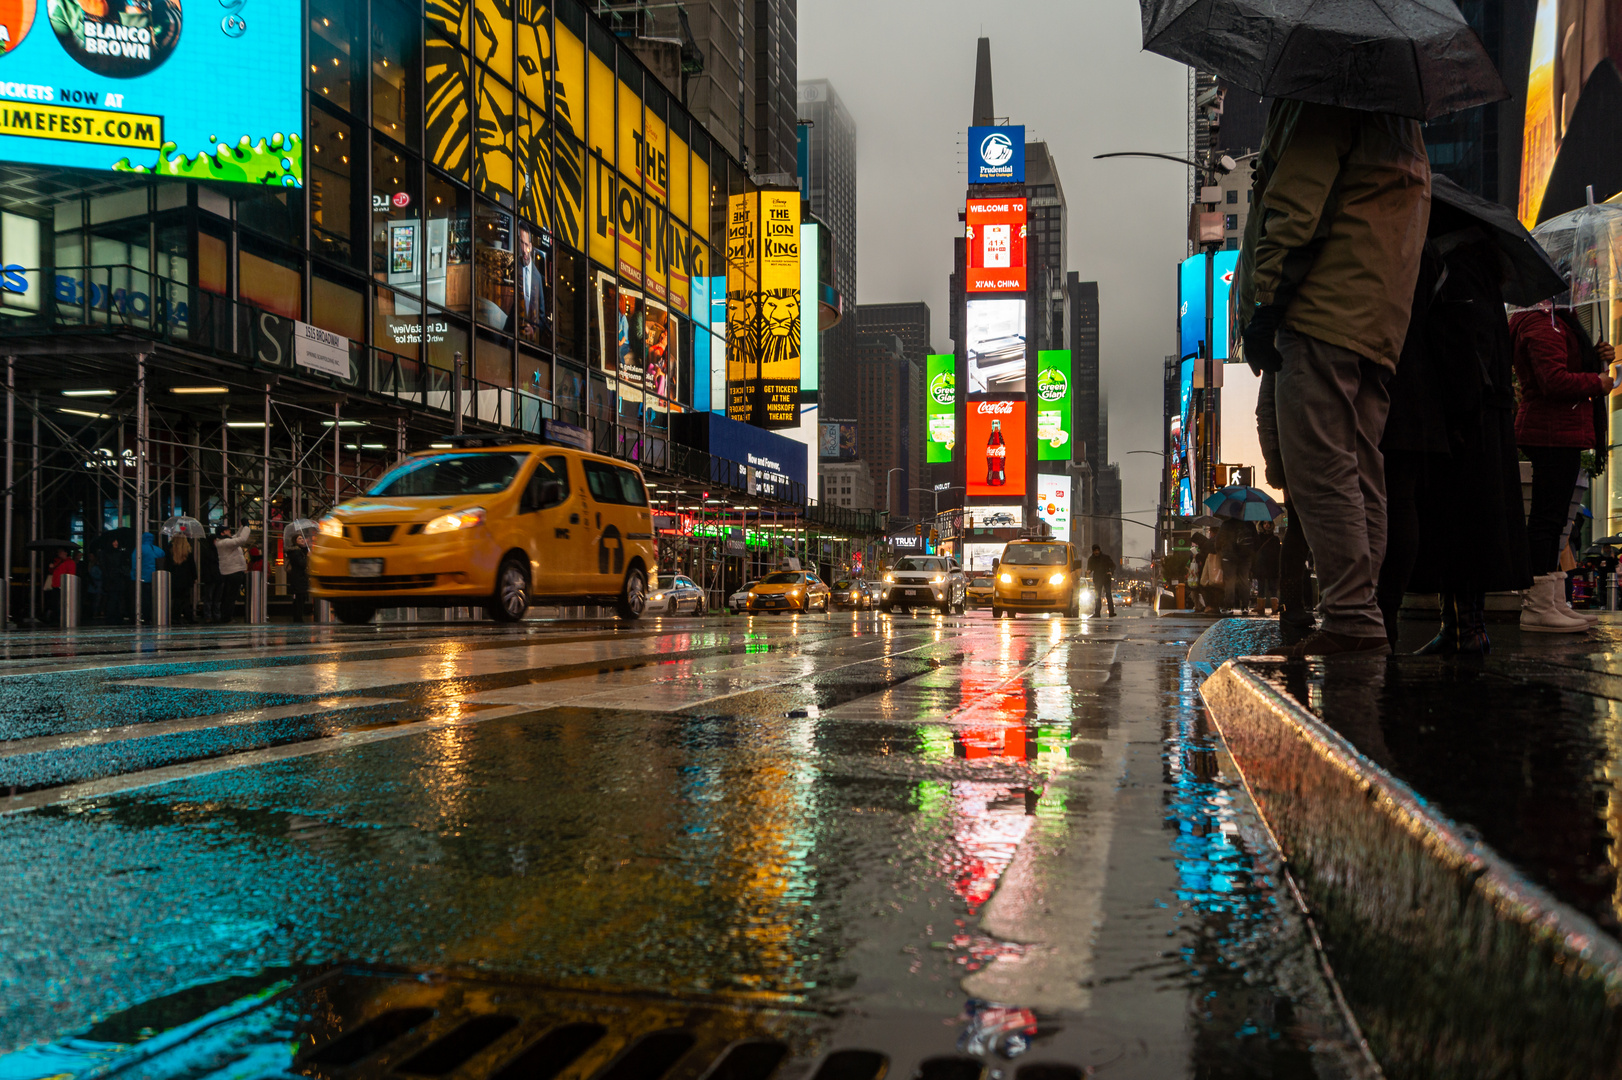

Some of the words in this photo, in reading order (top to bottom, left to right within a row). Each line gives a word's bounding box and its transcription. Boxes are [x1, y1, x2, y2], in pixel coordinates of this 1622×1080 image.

[84, 20, 151, 44] BLANCO
[85, 37, 151, 60] BROWN
[60, 88, 99, 105] NOW
[104, 93, 124, 108] AT
[0, 109, 155, 141] IMEFEST.COM
[633, 128, 666, 189] THE
[980, 165, 1013, 174] Prudential
[769, 209, 789, 219] THE
[970, 204, 1009, 212] WELCOME
[1013, 204, 1024, 212] TO
[596, 146, 652, 250] LION
[655, 195, 704, 286] KING
[766, 220, 793, 237] LION
[764, 238, 798, 258] KING
[620, 261, 642, 285] ENTRANCE
[646, 276, 654, 290] ON
[975, 280, 996, 288] XI'AN,
[997, 279, 1020, 288] CHINA
[305, 325, 315, 339] 1515
[316, 328, 340, 347] BROADWAY
[764, 385, 775, 393] GET
[775, 385, 798, 393] TICKETS
[1039, 383, 1065, 391] Green
[771, 394, 779, 402] AT
[780, 394, 790, 402] THE
[1041, 390, 1066, 399] Giant
[766, 403, 795, 411] MINSKOFF
[977, 401, 1015, 414] Coca-Cola
[769, 412, 793, 420] THEATRE
[828, 425, 838, 455] FROZEN
[748, 452, 757, 465] Now
[757, 457, 765, 467] and
[934, 482, 951, 491] INGLOT
[895, 537, 917, 545] TRULY
